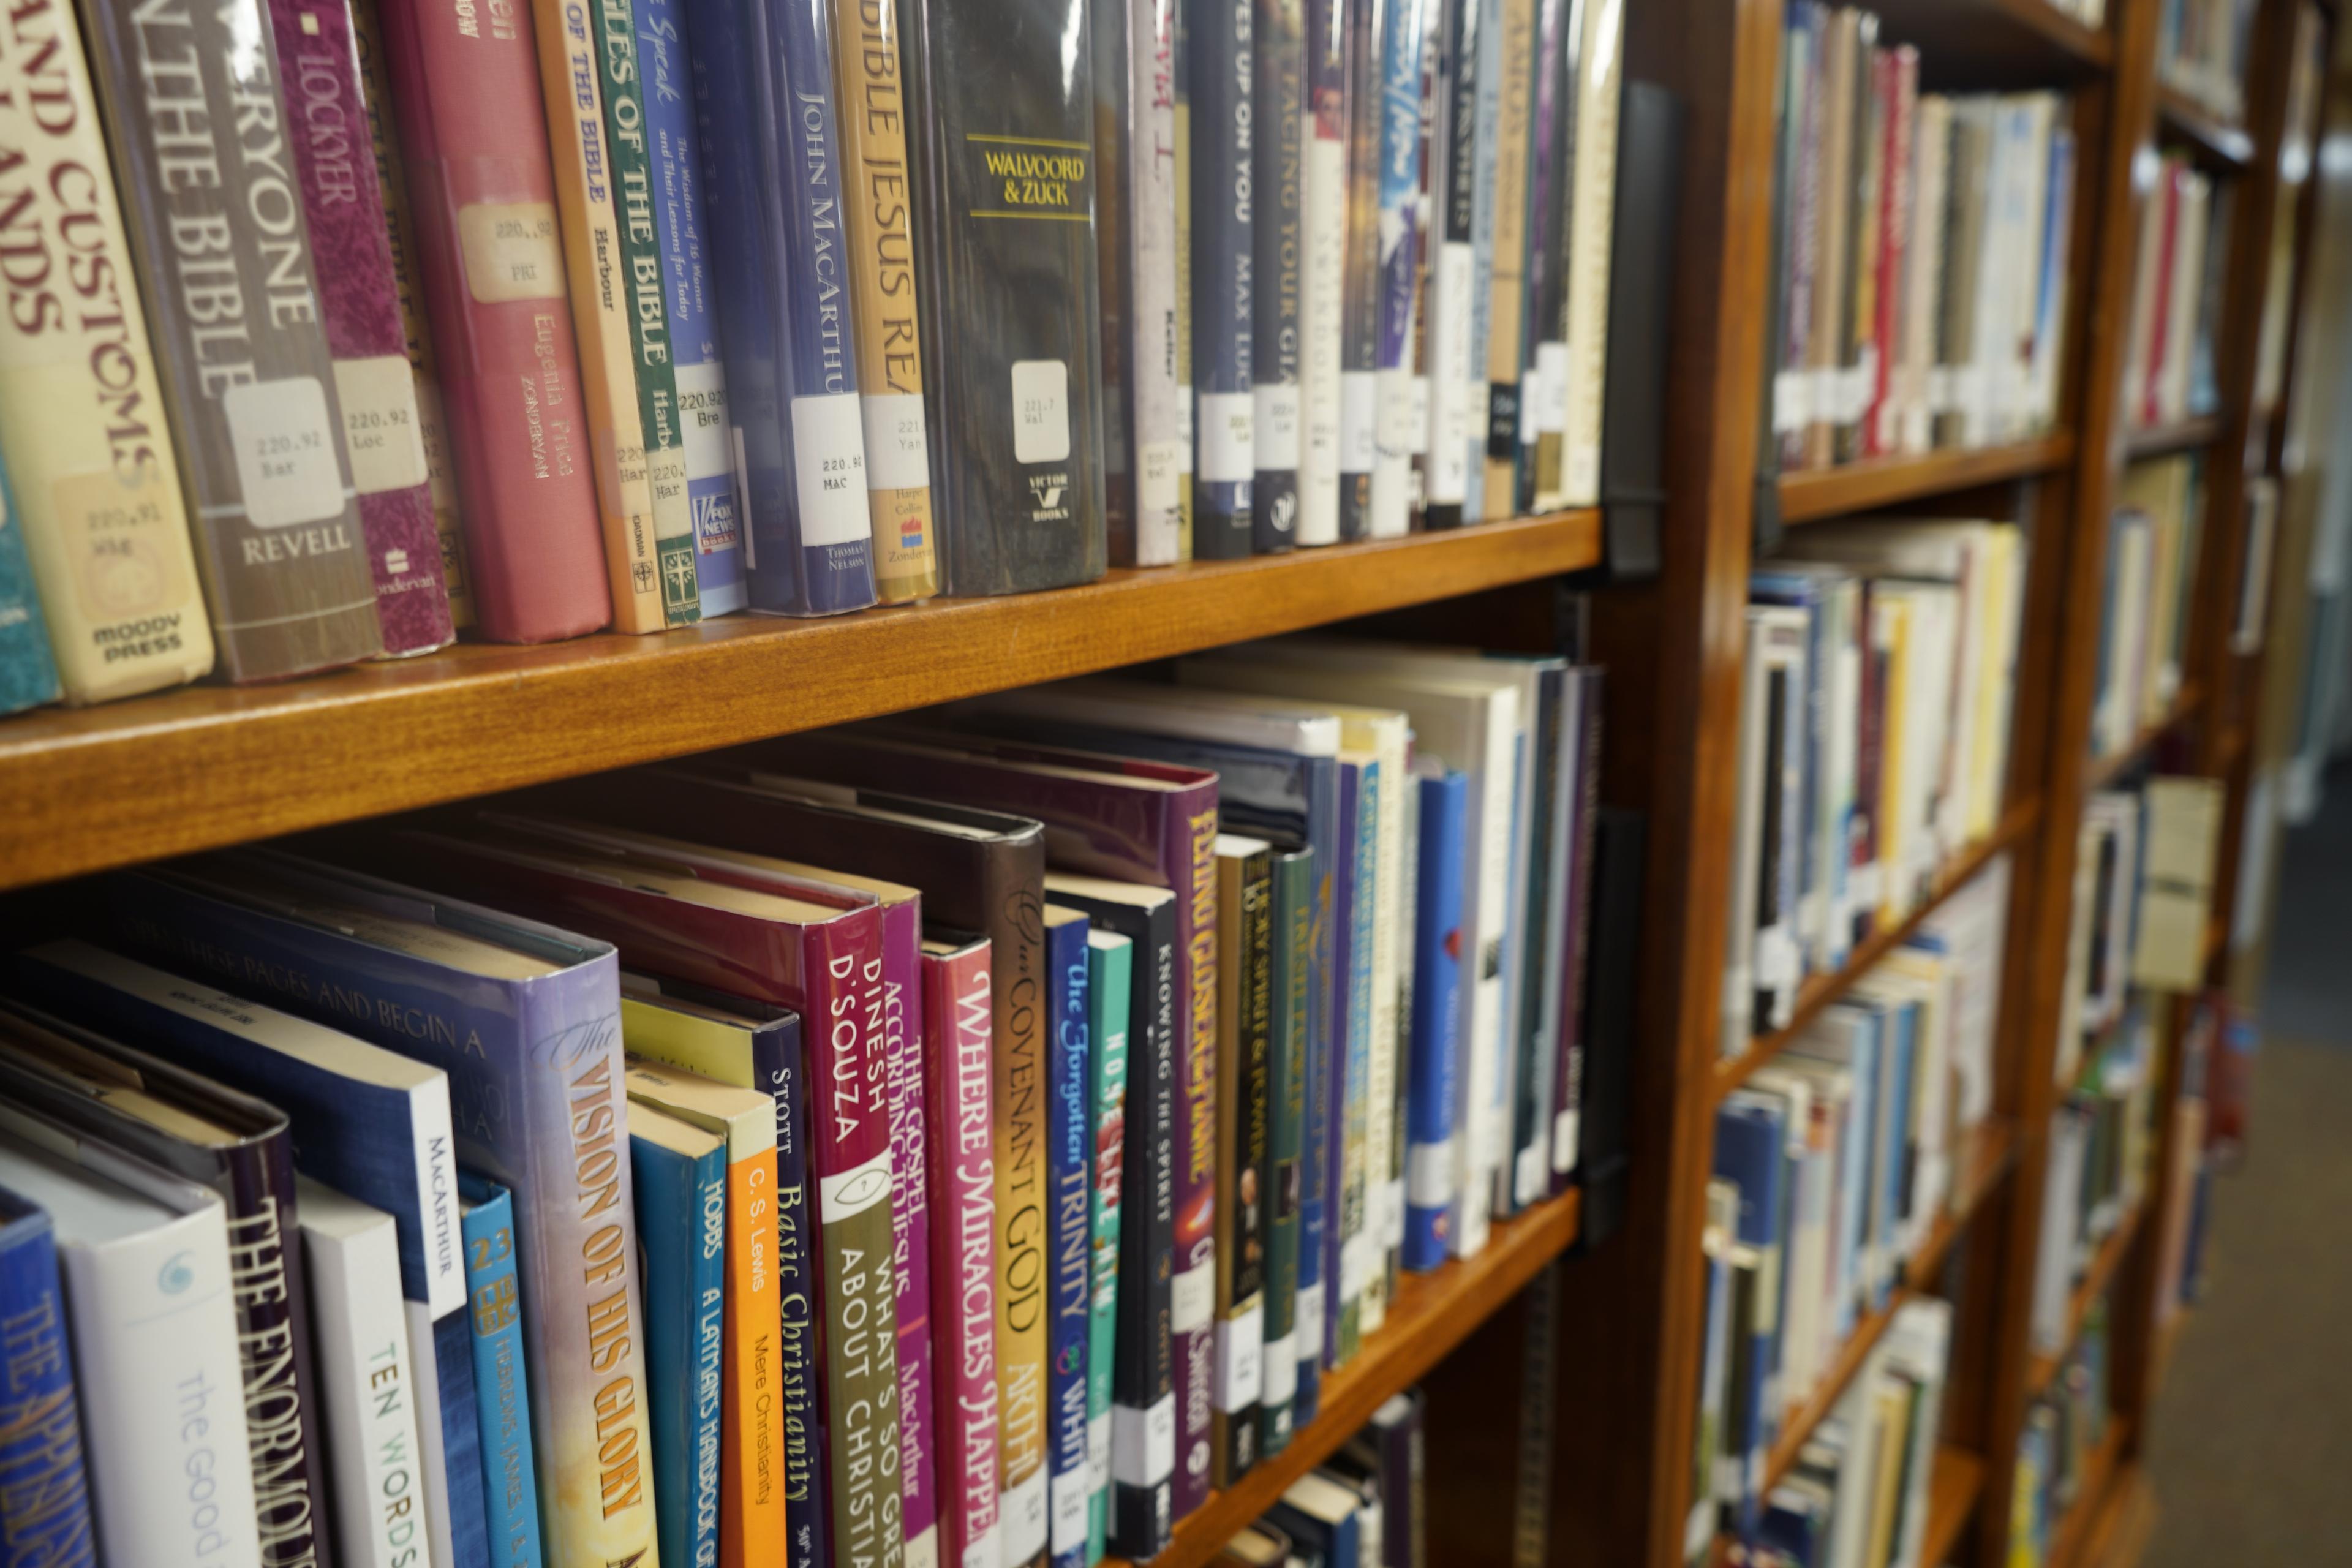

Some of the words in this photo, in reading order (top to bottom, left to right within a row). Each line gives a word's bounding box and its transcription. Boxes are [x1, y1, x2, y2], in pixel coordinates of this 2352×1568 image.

[566, 4, 586, 42] OF
[573, 53, 595, 111] THE
[638, 13, 681, 108] Speak
[1235, 51, 1252, 94] UP
[141, 44, 222, 195] THE
[296, 55, 358, 206] LOCKYER
[614, 94, 644, 154] OF
[659, 128, 673, 158] and
[677, 137, 688, 163] The
[796, 93, 827, 186] JOHN
[1235, 101, 1252, 150] ON
[1280, 72, 1299, 209] FACING
[581, 119, 606, 203] BIBLE
[663, 160, 677, 196] Their
[680, 165, 694, 219] Wisdom
[984, 151, 1085, 183] WALVOORD
[1003, 179, 1020, 203] &
[1022, 182, 1070, 206] ZUCK
[1235, 159, 1252, 224] YOU
[622, 165, 654, 246] THE
[667, 201, 681, 255] Lessons
[684, 219, 699, 242] of
[864, 156, 911, 299] JESUS
[510, 263, 538, 281] PRI
[594, 228, 614, 311] Harbour
[670, 254, 686, 279] for
[676, 279, 689, 322] Today
[692, 263, 704, 313] Women
[810, 195, 845, 394] MACARTHU
[1234, 252, 1253, 322] MAX
[1279, 221, 1298, 318] YOUR
[48, 160, 164, 489] CUSTOMS
[168, 211, 257, 399] BIBLE
[633, 254, 668, 367] BIBLE
[534, 313, 563, 406] Eugenia
[1234, 333, 1253, 393] LUC
[1278, 326, 1297, 387] GIA
[255, 431, 322, 456] 220.92
[347, 409, 410, 430] 220.92
[521, 374, 549, 479] ZONDERVAN
[698, 411, 720, 428] Bre
[261, 461, 296, 480] Bar
[620, 467, 647, 483] Har
[654, 460, 686, 482] 220.
[656, 484, 680, 500] Har
[823, 478, 847, 490] MAC
[1029, 473, 1069, 488] VICTOR
[241, 524, 353, 565] REVELL
[704, 519, 735, 537] NEWS
[710, 503, 734, 521] FOX
[1032, 507, 1070, 522] BOOKS
[827, 545, 864, 559] THOMAS
[827, 559, 864, 571] NELSON
[93, 612, 181, 646] MOODY
[104, 633, 183, 663] PRESS
[1188, 809, 1218, 926] FLYING
[1253, 880, 1272, 953] HOLY
[181, 936, 241, 980] THESE
[243, 956, 312, 1003] PAGES
[317, 981, 371, 1021] AND
[377, 998, 458, 1046] BEGIN
[464, 1028, 488, 1060] A
[1157, 944, 1174, 1081] KNOWING
[1187, 931, 1217, 1055] CLOSER
[1252, 956, 1270, 1033] SPIRIT
[529, 1000, 620, 1072] The
[829, 955, 859, 1144] D'SOUZA
[863, 957, 886, 1113] DINESH
[904, 1035, 923, 1104] THE
[955, 970, 992, 1157] WHERE
[771, 1067, 793, 1155] STOTT
[1008, 976, 1036, 1195] COVENANT
[1059, 1018, 1089, 1165] Forgotten
[1158, 1088, 1172, 1133] THE
[568, 1054, 624, 1224] VISION
[905, 1107, 926, 1224] GOSPEL
[429, 1136, 452, 1277] MACARTHUR
[748, 1166, 766, 1197] C.
[748, 1198, 766, 1223] S.
[891, 1161, 908, 1209] TO
[1156, 1139, 1172, 1223] SPIRIT
[228, 1196, 288, 1312] THE
[469, 1226, 513, 1273] 23
[582, 1220, 627, 1287] OF
[703, 1178, 723, 1261] HOBBS
[776, 1183, 805, 1279] Basic
[1061, 1159, 1088, 1317] TRINITY
[749, 1226, 766, 1292] Lewis
[956, 1158, 998, 1380] MIRACLES
[1005, 1203, 1042, 1333] GOD
[587, 1284, 633, 1377] HIS
[702, 1287, 721, 1308] A
[840, 1247, 869, 1379] ABOUT
[875, 1253, 896, 1408] WHAT'S
[2, 1289, 62, 1396] THE
[753, 1334, 770, 1391] Mere
[369, 1341, 401, 1422] TEN
[780, 1291, 816, 1504] Christianity
[593, 1375, 644, 1523] GLORY
[755, 1394, 774, 1507] Christianity
[878, 1423, 899, 1477] SO
[899, 1361, 921, 1498] MacArthur
[379, 1430, 419, 1568] WORDS
[697, 1420, 721, 1536] HANDBOOK
